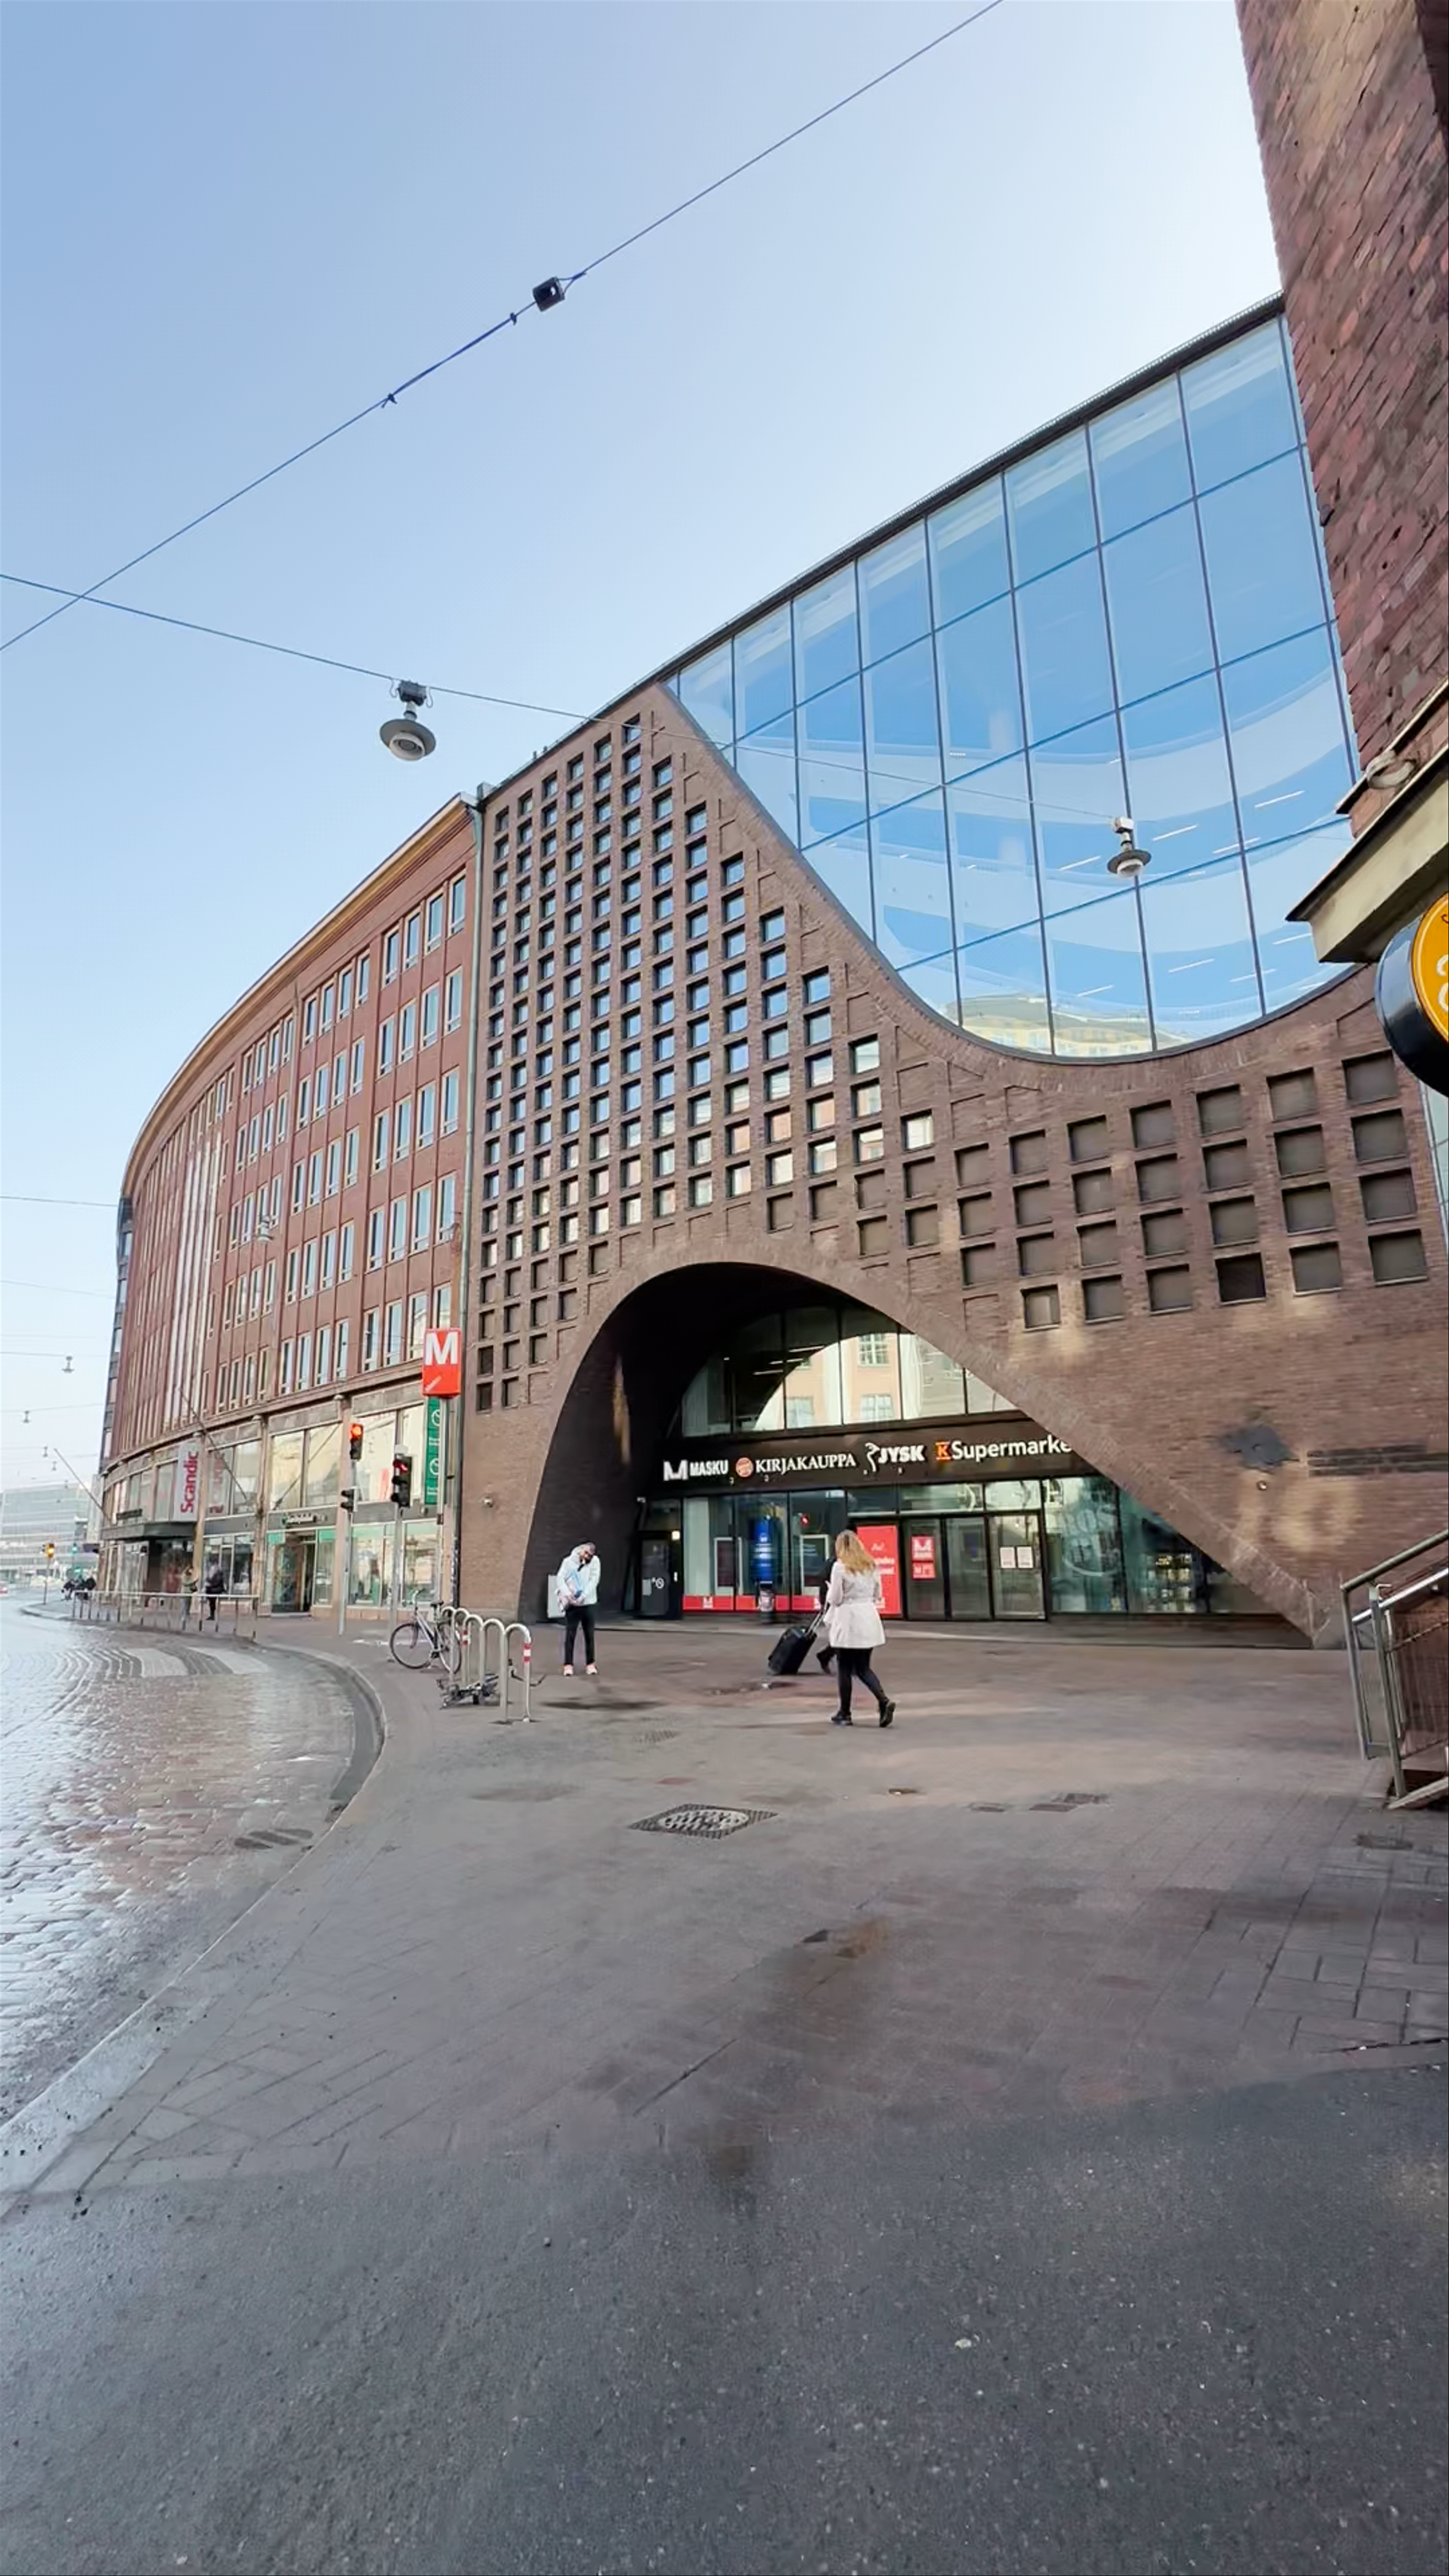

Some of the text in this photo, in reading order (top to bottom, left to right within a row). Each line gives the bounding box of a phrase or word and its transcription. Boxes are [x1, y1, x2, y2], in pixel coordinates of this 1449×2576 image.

[425, 1332, 459, 1365] M
[756, 1454, 856, 1475] KIRJAKAUPPA
[878, 1445, 925, 1464] JYSK
[690, 1459, 729, 1476] MASKU
[180, 1451, 199, 1513] Scandic
